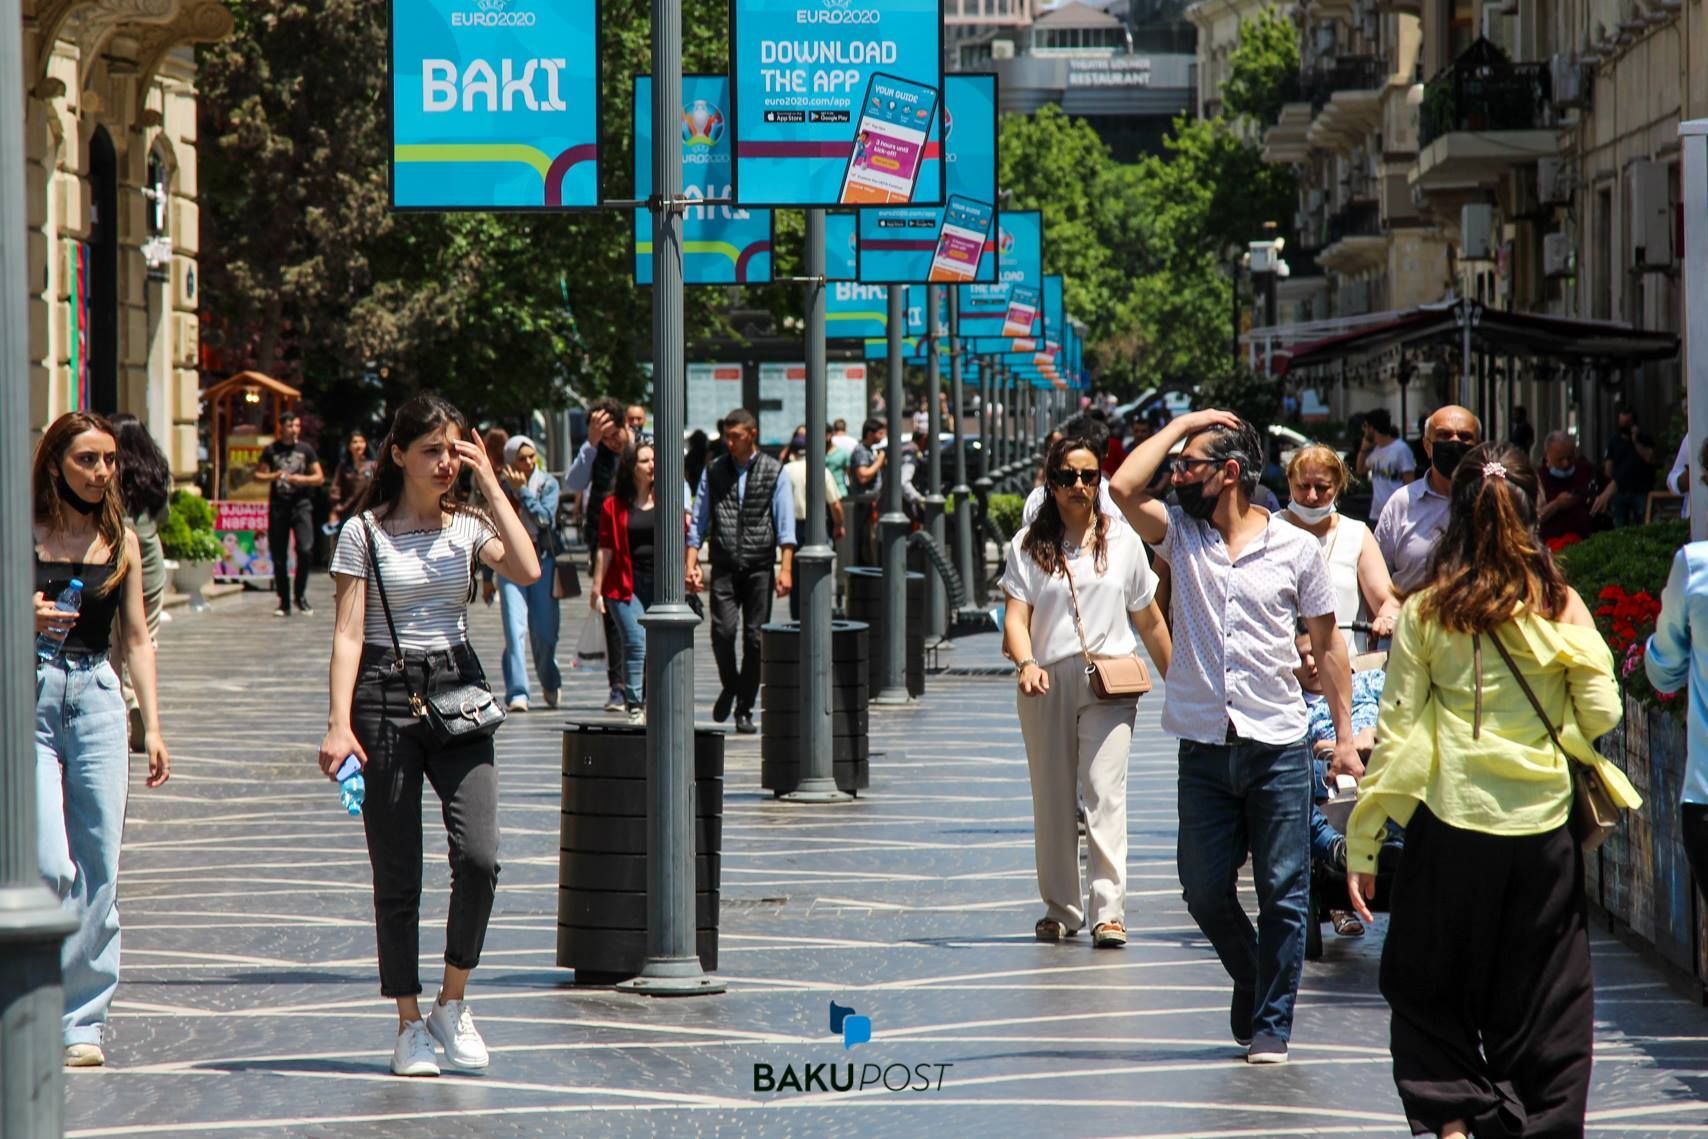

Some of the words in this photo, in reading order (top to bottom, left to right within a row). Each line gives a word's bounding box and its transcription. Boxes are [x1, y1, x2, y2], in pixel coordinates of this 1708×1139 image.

[451, 12, 536, 26] EURO2020
[796, 10, 880, 24] EURO2020
[761, 40, 897, 64] DOWNLOAD
[422, 58, 566, 112] BAKI
[761, 69, 807, 93] THE
[813, 69, 860, 93] APP
[1070, 72, 1151, 85] RESTAURANT
[875, 84, 895, 98] YOUR
[895, 90, 919, 104] GUIDE
[764, 97, 851, 107] euro2020.com/app
[682, 153, 731, 164] URO2020
